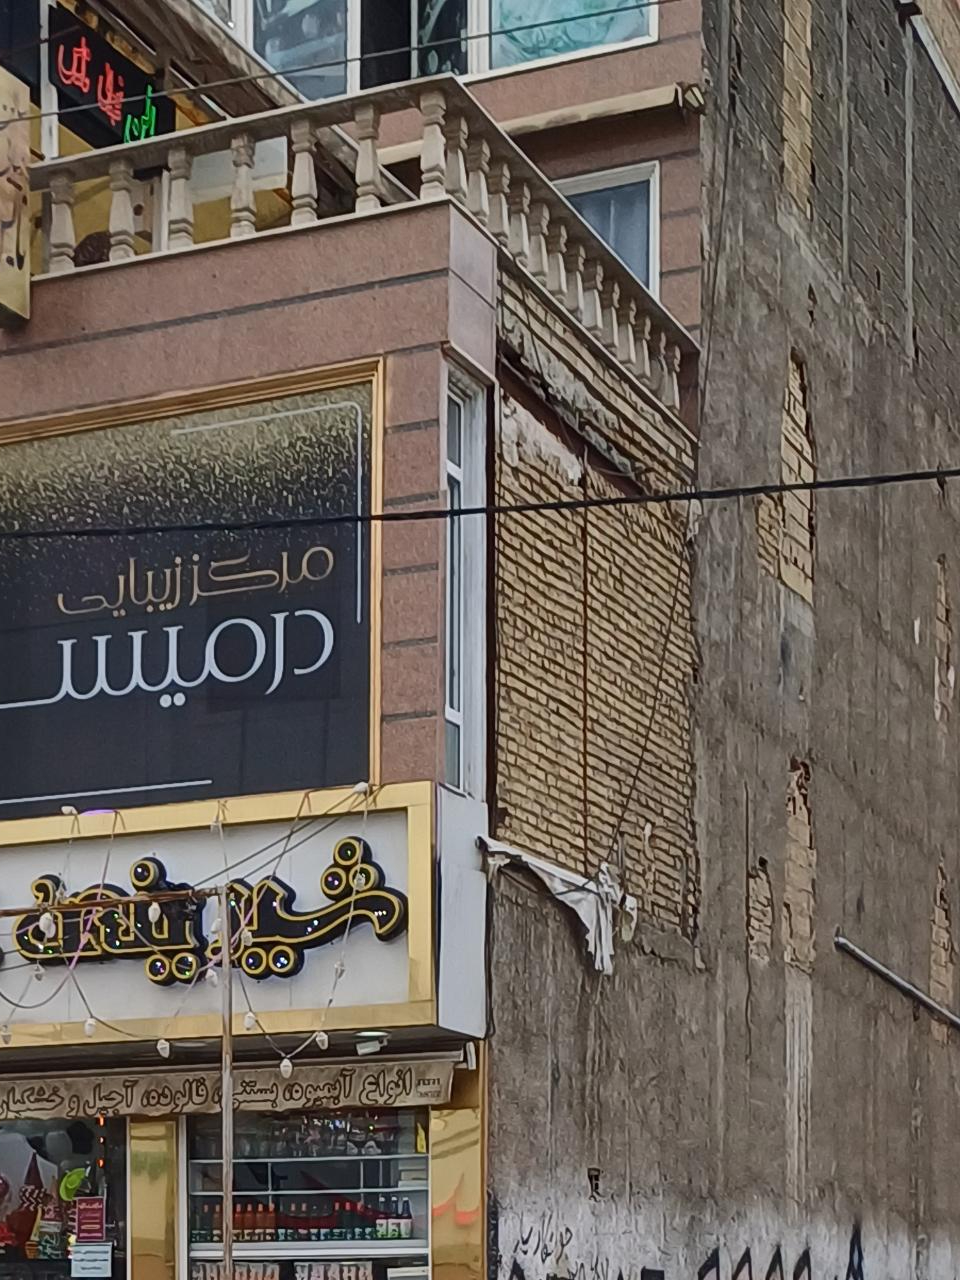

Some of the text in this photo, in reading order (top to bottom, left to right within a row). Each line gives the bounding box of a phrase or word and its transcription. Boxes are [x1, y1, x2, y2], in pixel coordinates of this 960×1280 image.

[56, 546, 334, 618] مرکز زیبایی
[359, 1067, 413, 1106] انواع
